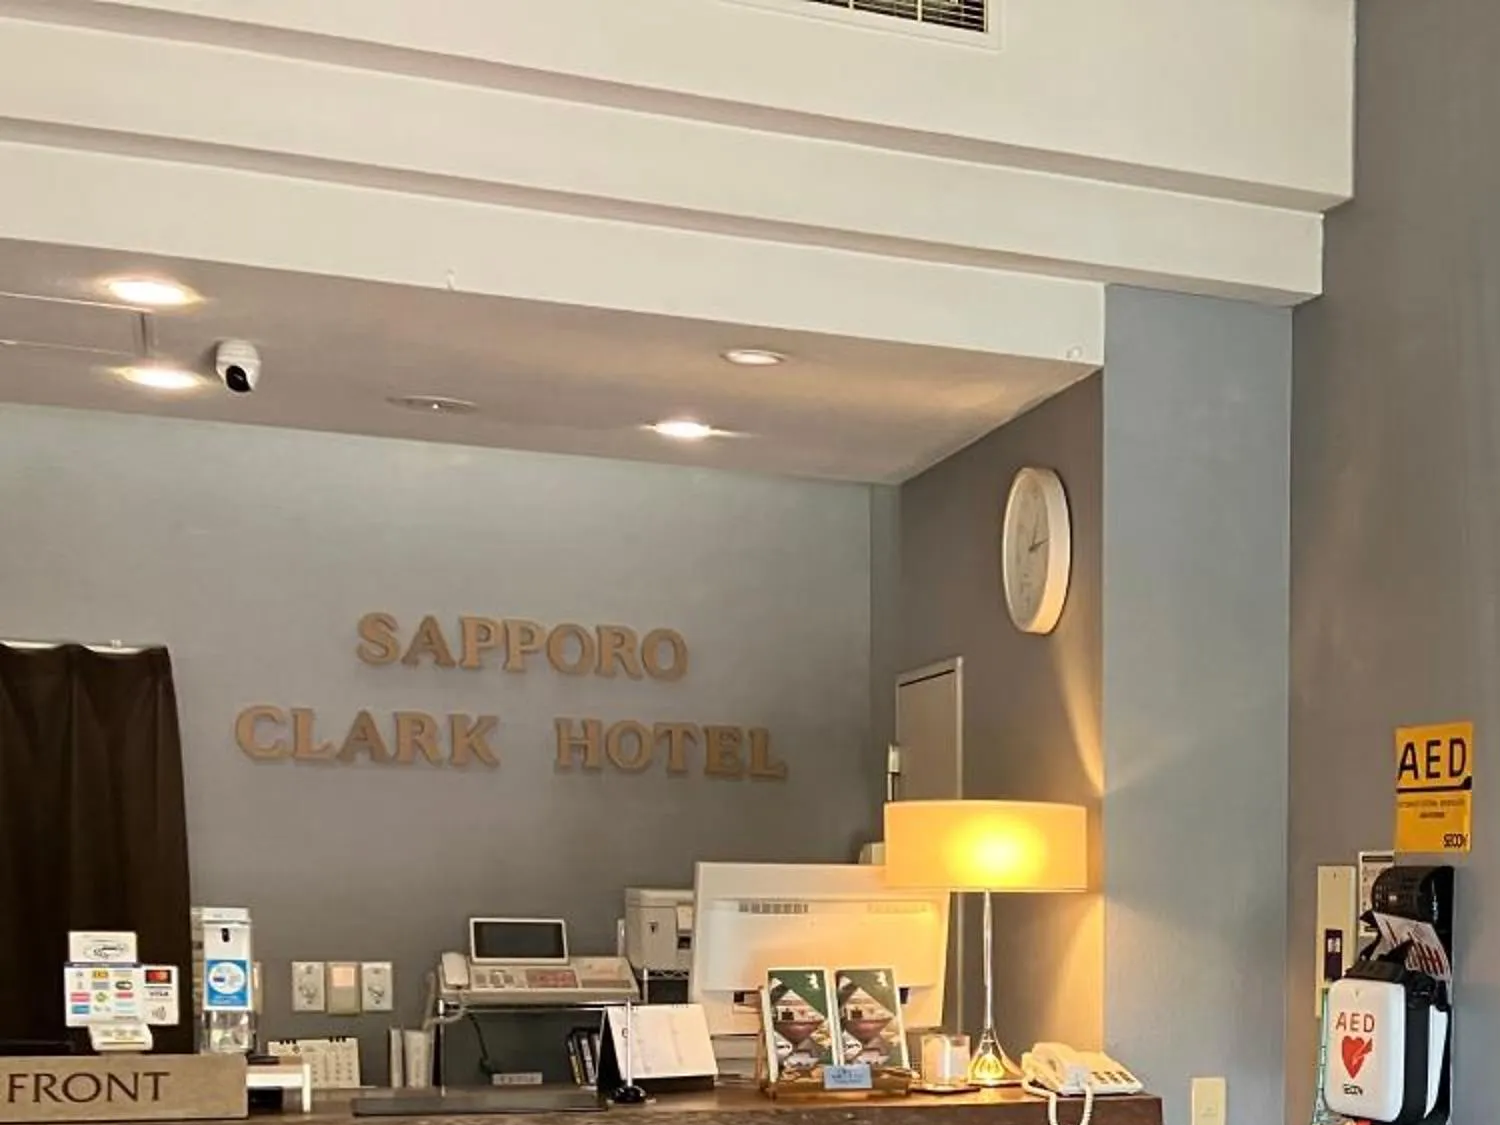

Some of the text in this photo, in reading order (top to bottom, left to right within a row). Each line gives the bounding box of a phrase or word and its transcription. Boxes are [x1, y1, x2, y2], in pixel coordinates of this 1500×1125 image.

[356, 612, 688, 682] SAPPORO
[234, 705, 787, 779] CLARK HOTEL
[1397, 737, 1467, 780] AED
[1335, 1011, 1375, 1033] AED
[8, 1072, 170, 1103] FRONT
